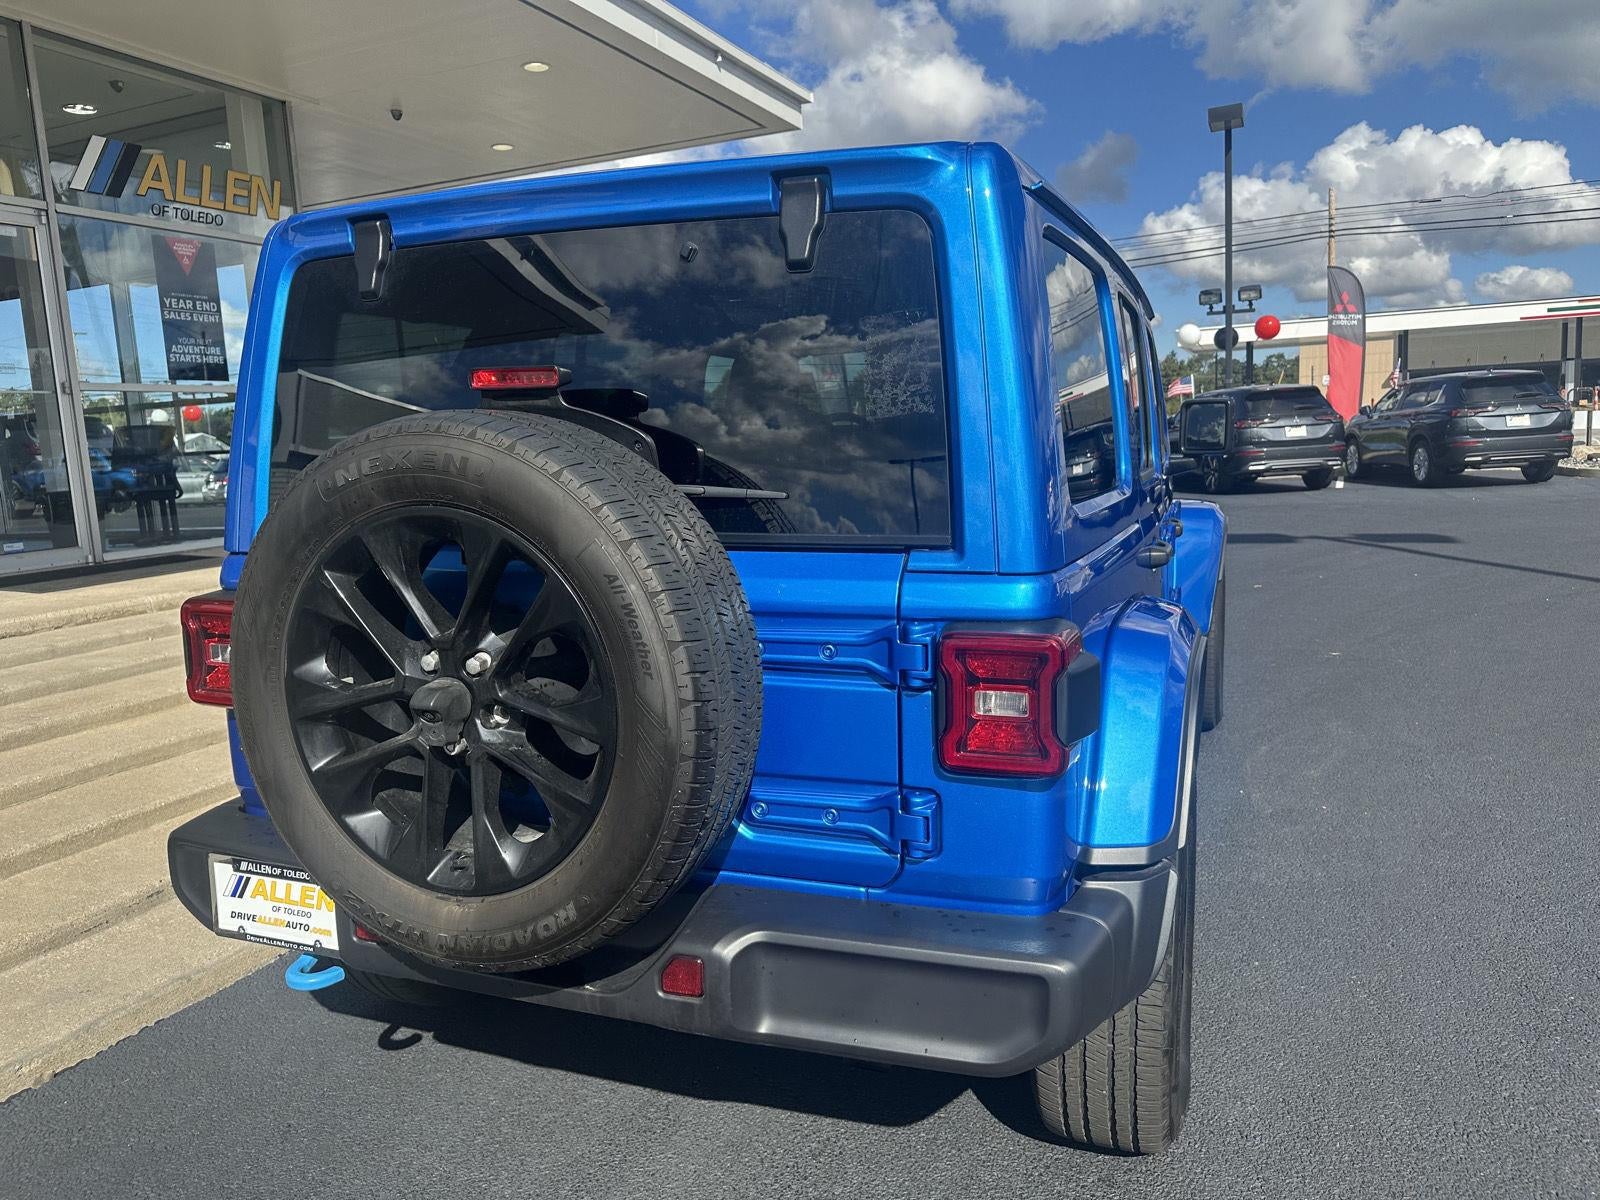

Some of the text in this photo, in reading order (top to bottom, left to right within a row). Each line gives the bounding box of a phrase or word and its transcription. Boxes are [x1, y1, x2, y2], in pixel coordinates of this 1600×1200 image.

[136, 153, 281, 220] ALLEN
[151, 203, 224, 227] OF TOLEDO
[163, 297, 218, 312] YEAR END
[163, 310, 220, 323] SALES EVENT
[177, 336, 195, 345] YOUR
[171, 344, 221, 355] ADVENTURE
[169, 353, 225, 365] STARTS HERE
[334, 450, 471, 488] NEXEN
[603, 573, 653, 681] All-Weather
[247, 861, 272, 875] ALLEN
[271, 866, 282, 876] OF
[250, 878, 335, 913] ALLEN
[271, 905, 312, 919] OF TOLEDO
